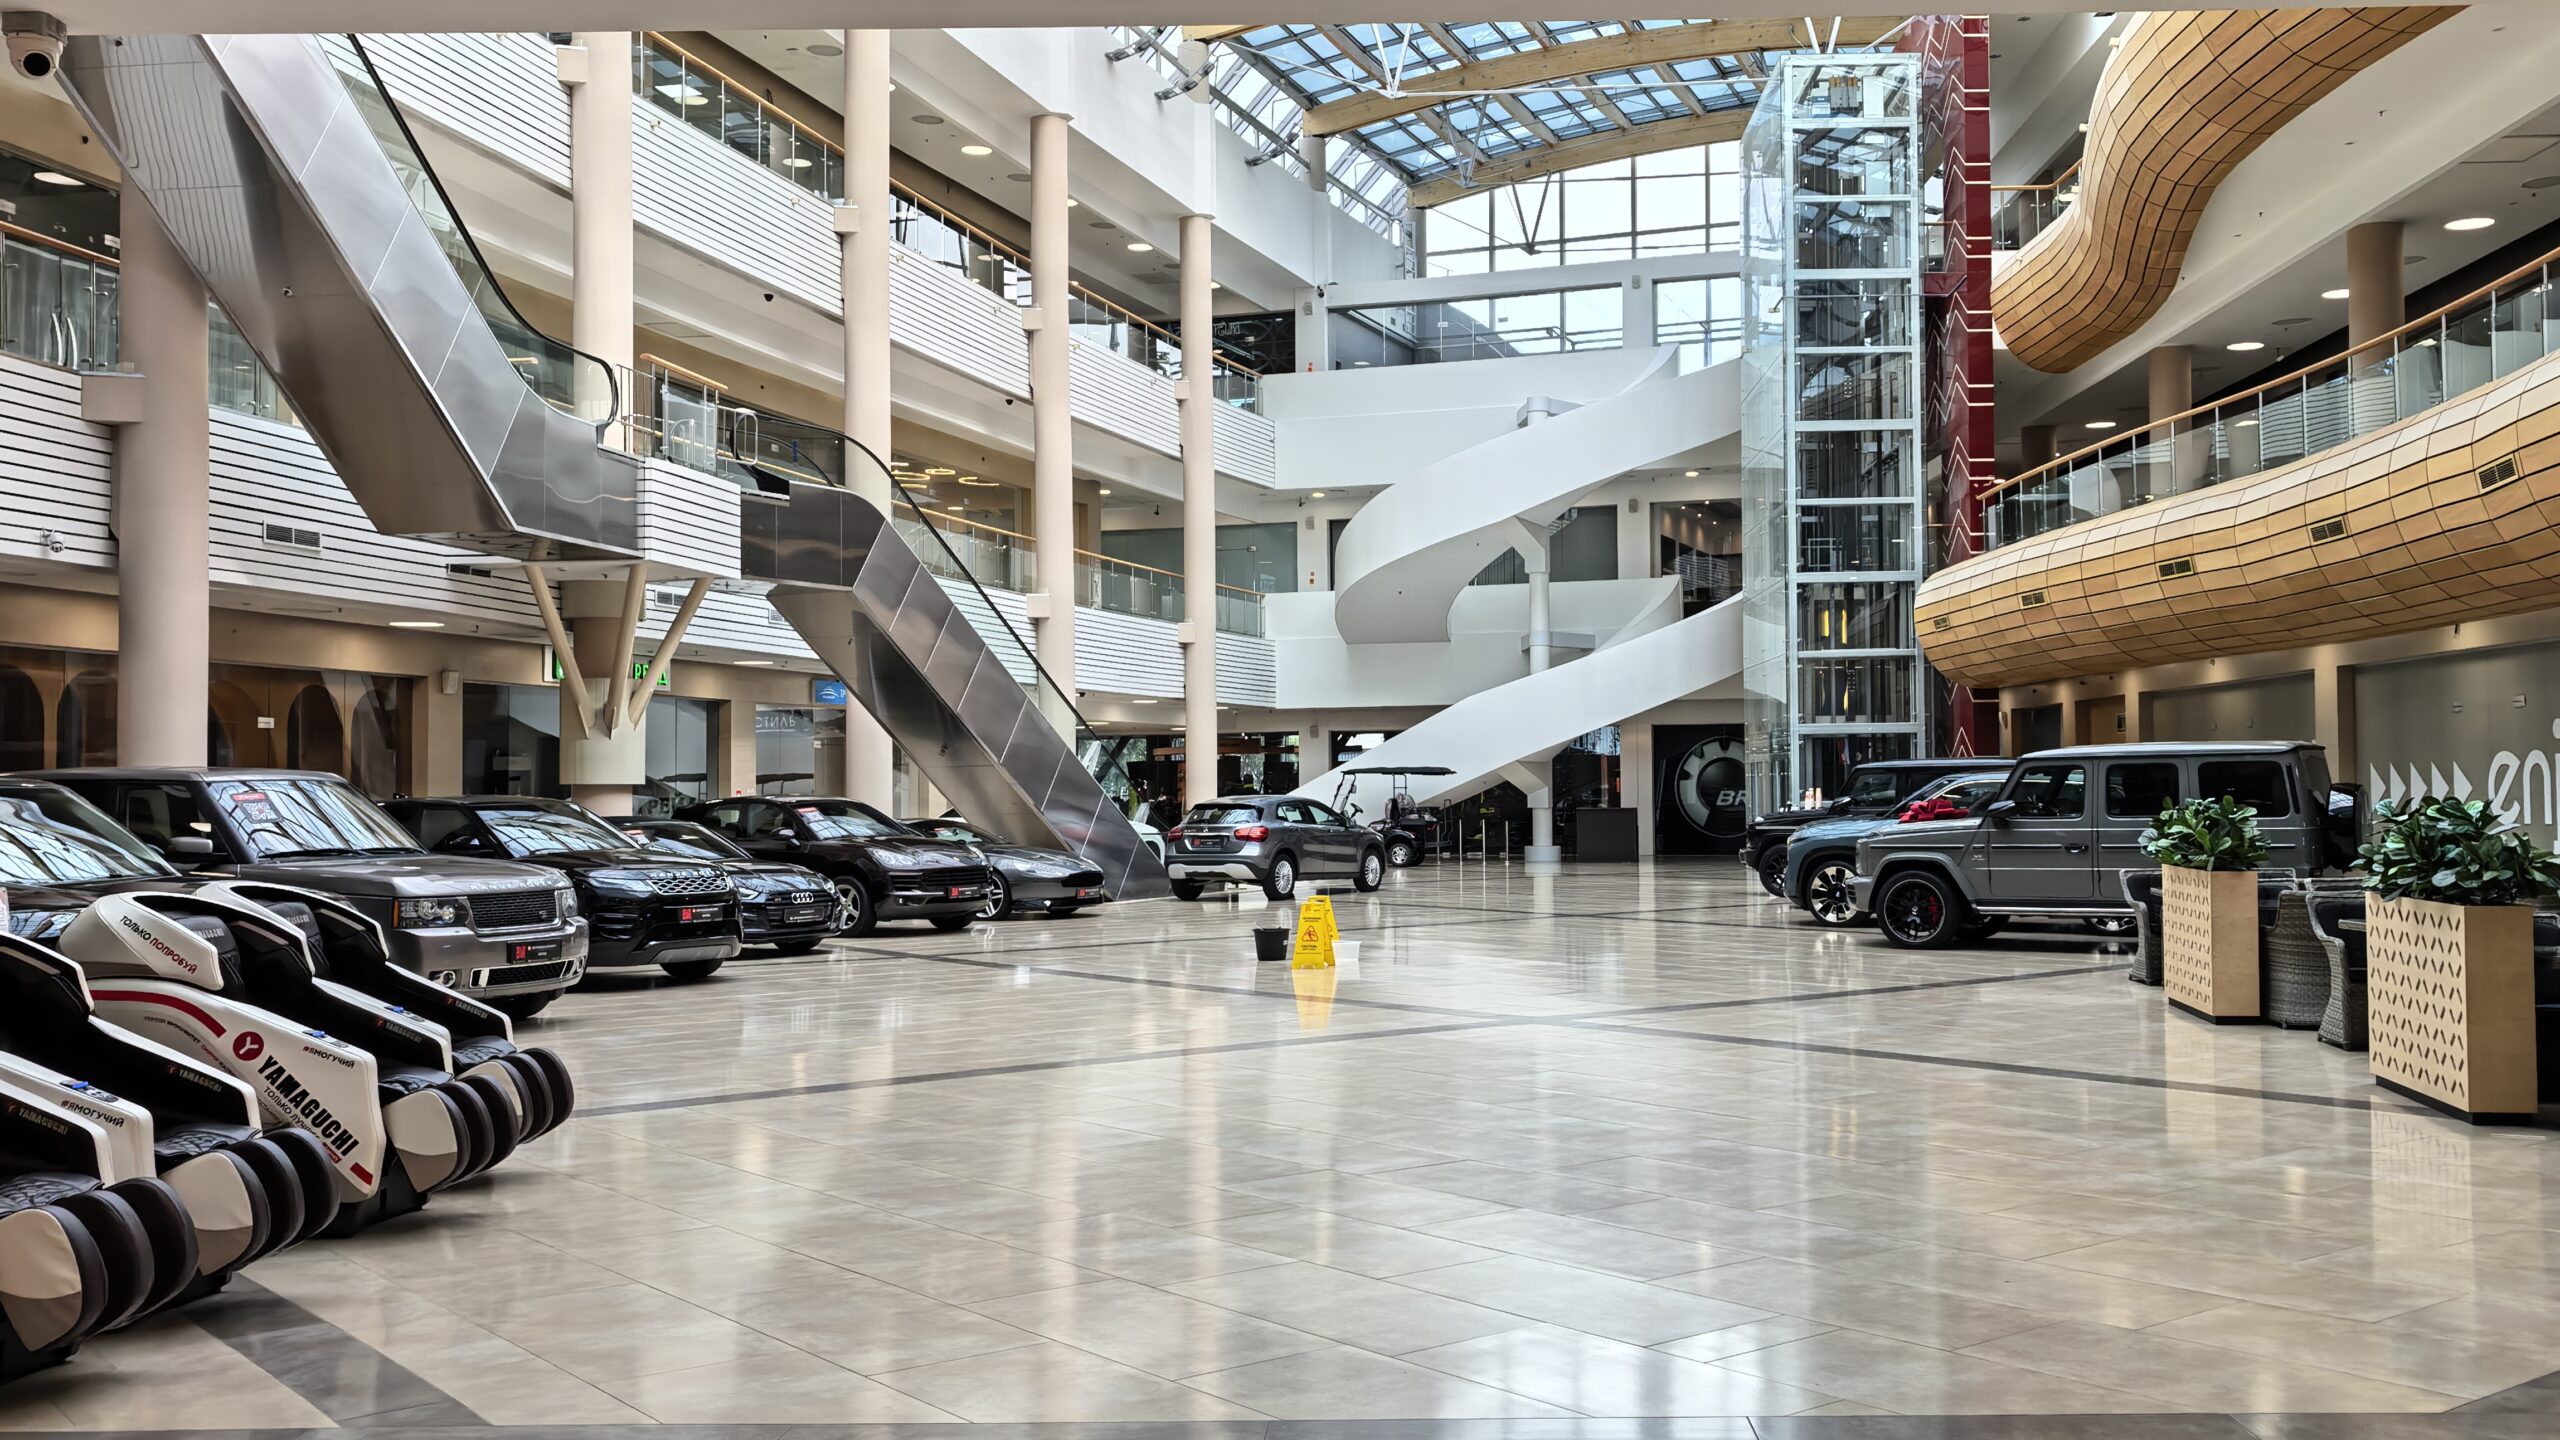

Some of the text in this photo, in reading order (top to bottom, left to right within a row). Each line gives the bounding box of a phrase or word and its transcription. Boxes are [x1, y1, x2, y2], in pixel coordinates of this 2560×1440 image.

[120, 915, 198, 975] ТОЛЬКО ПОПРОБУЙ
[302, 1045, 355, 1069] #ЯМОГУЧИЙ
[60, 1100, 124, 1128] #ЯМОГУЧИЙ
[258, 1055, 360, 1157] YAMAGUCHI
[264, 1086, 292, 1115] ТОЛЬКО
